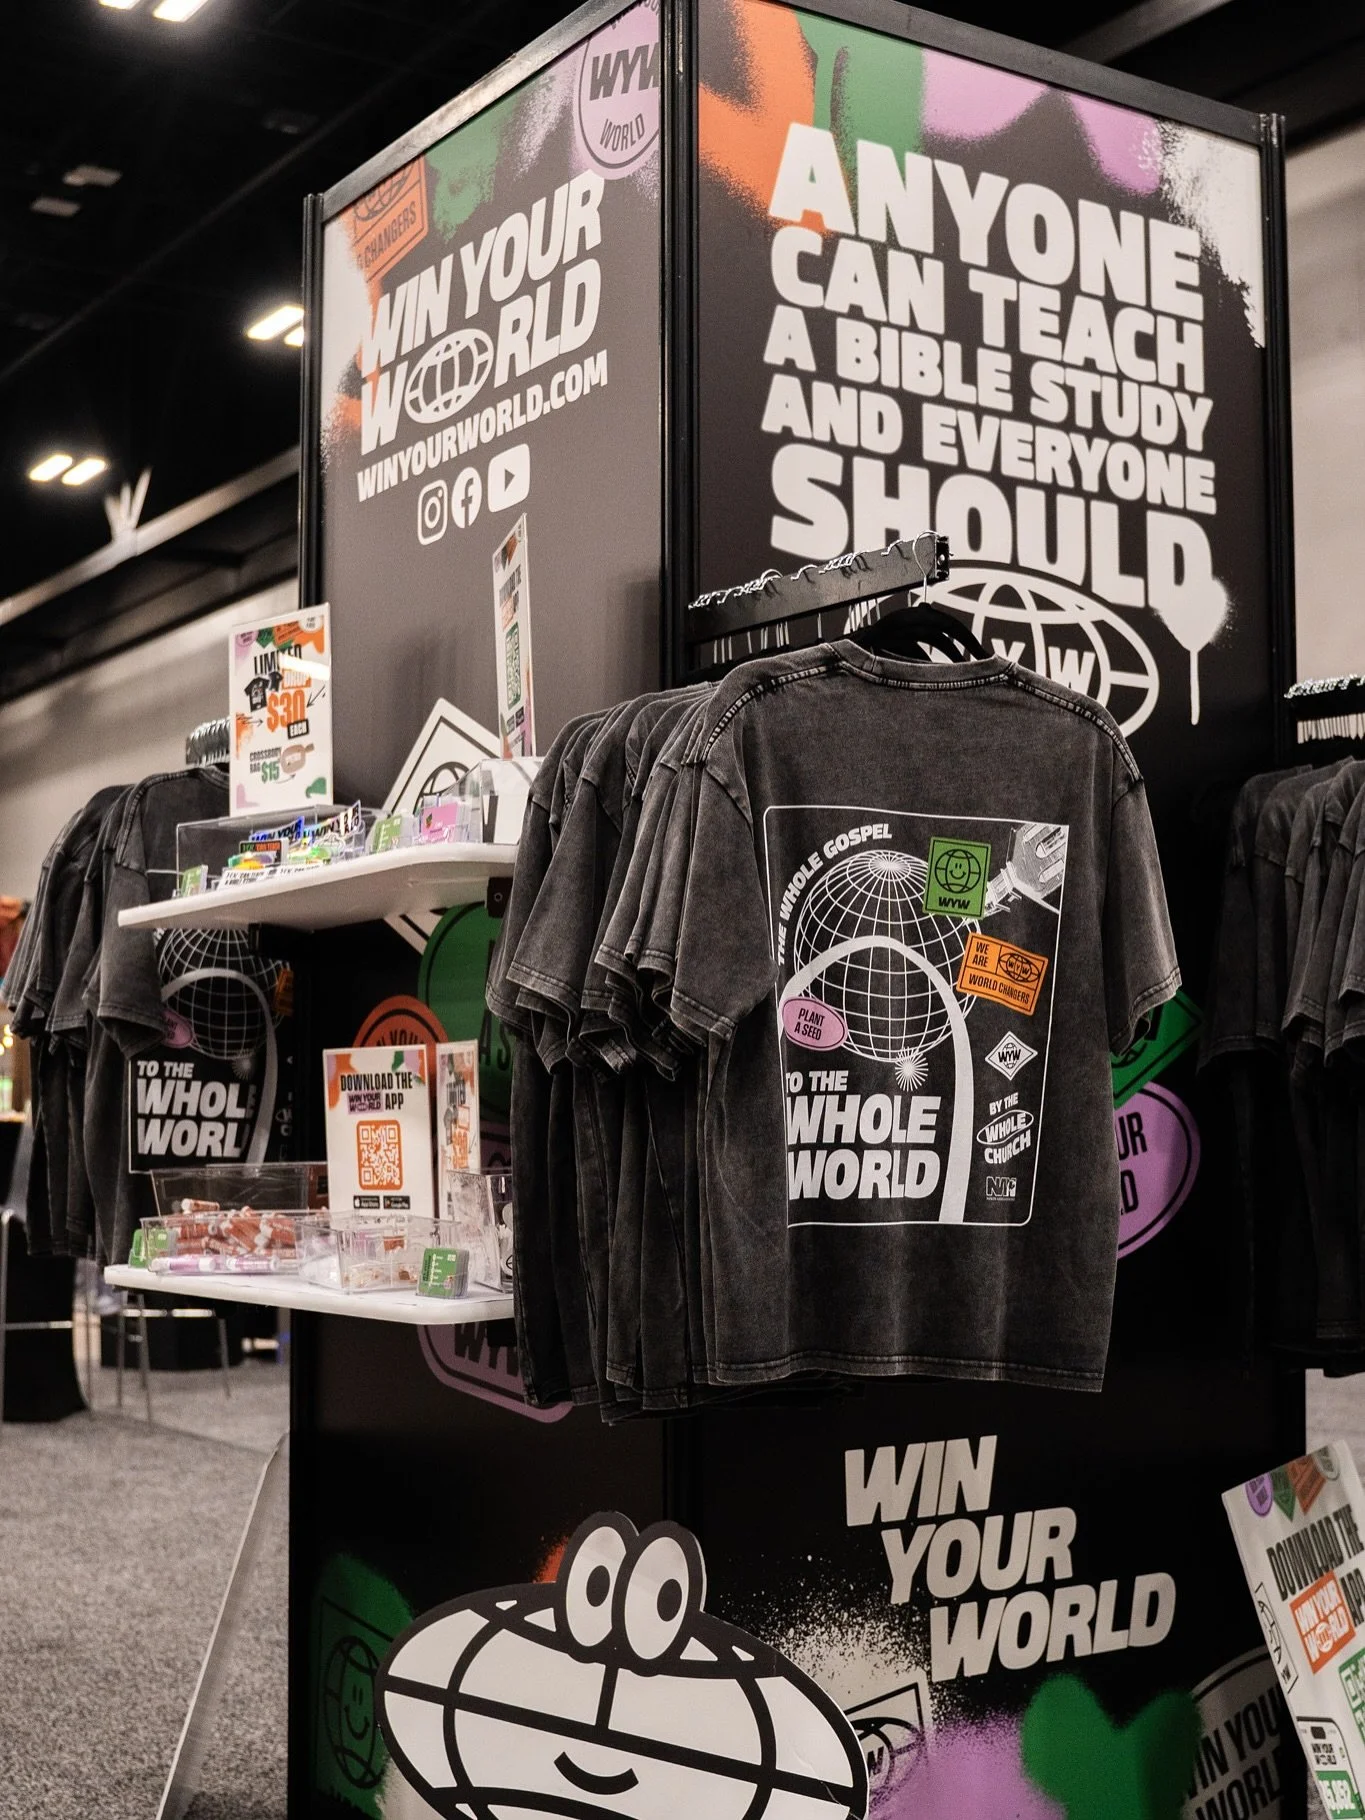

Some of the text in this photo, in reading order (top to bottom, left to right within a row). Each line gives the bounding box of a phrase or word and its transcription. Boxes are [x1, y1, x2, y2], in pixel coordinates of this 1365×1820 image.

[600, 113, 645, 152] WORLD
[364, 201, 416, 268] CHANGERS
[768, 122, 1204, 320] ANYONE
[361, 169, 604, 378] WIN YOUR
[770, 225, 1204, 393] CAN TEACH
[763, 305, 1213, 451] A BIBLE STUDY
[357, 350, 608, 502] WINYOURWORLD.COM
[761, 373, 1216, 515] AND EVERYONE
[771, 443, 1213, 609] SHOULD
[267, 689, 305, 732] $30
[289, 721, 307, 738] EACH
[261, 761, 280, 783] $15
[777, 823, 892, 966] THE WHOLE GOSPEL
[938, 896, 970, 910] WYW
[972, 954, 988, 968] ARE
[975, 941, 990, 955] WE
[968, 973, 1030, 1004] WORLD CHANGERS
[794, 1021, 822, 1041] A SEED
[798, 1008, 825, 1027] PLANT
[137, 1061, 194, 1078] TO THE
[998, 1049, 1021, 1063] WYW
[340, 1072, 413, 1091] DOWNLOAD THE
[364, 1092, 381, 1101] YOUR
[385, 1092, 404, 1110] APP
[809, 1070, 849, 1092] THE
[786, 1093, 941, 1146] WHOLE
[989, 1092, 1019, 1116] BY THE
[137, 1118, 248, 1158] WORL
[984, 1129, 1031, 1164] CHURCH
[985, 1112, 1027, 1143] WHOLE
[788, 1149, 940, 1200] WORLD
[845, 1435, 997, 1527] WIN
[881, 1507, 1077, 1604] YOUR
[1266, 1504, 1364, 1601] DOWNLOAD THE
[930, 1572, 1176, 1682] WORLD
[1295, 1580, 1341, 1635] WIN YOUR
[1224, 1683, 1284, 1762] YOU
